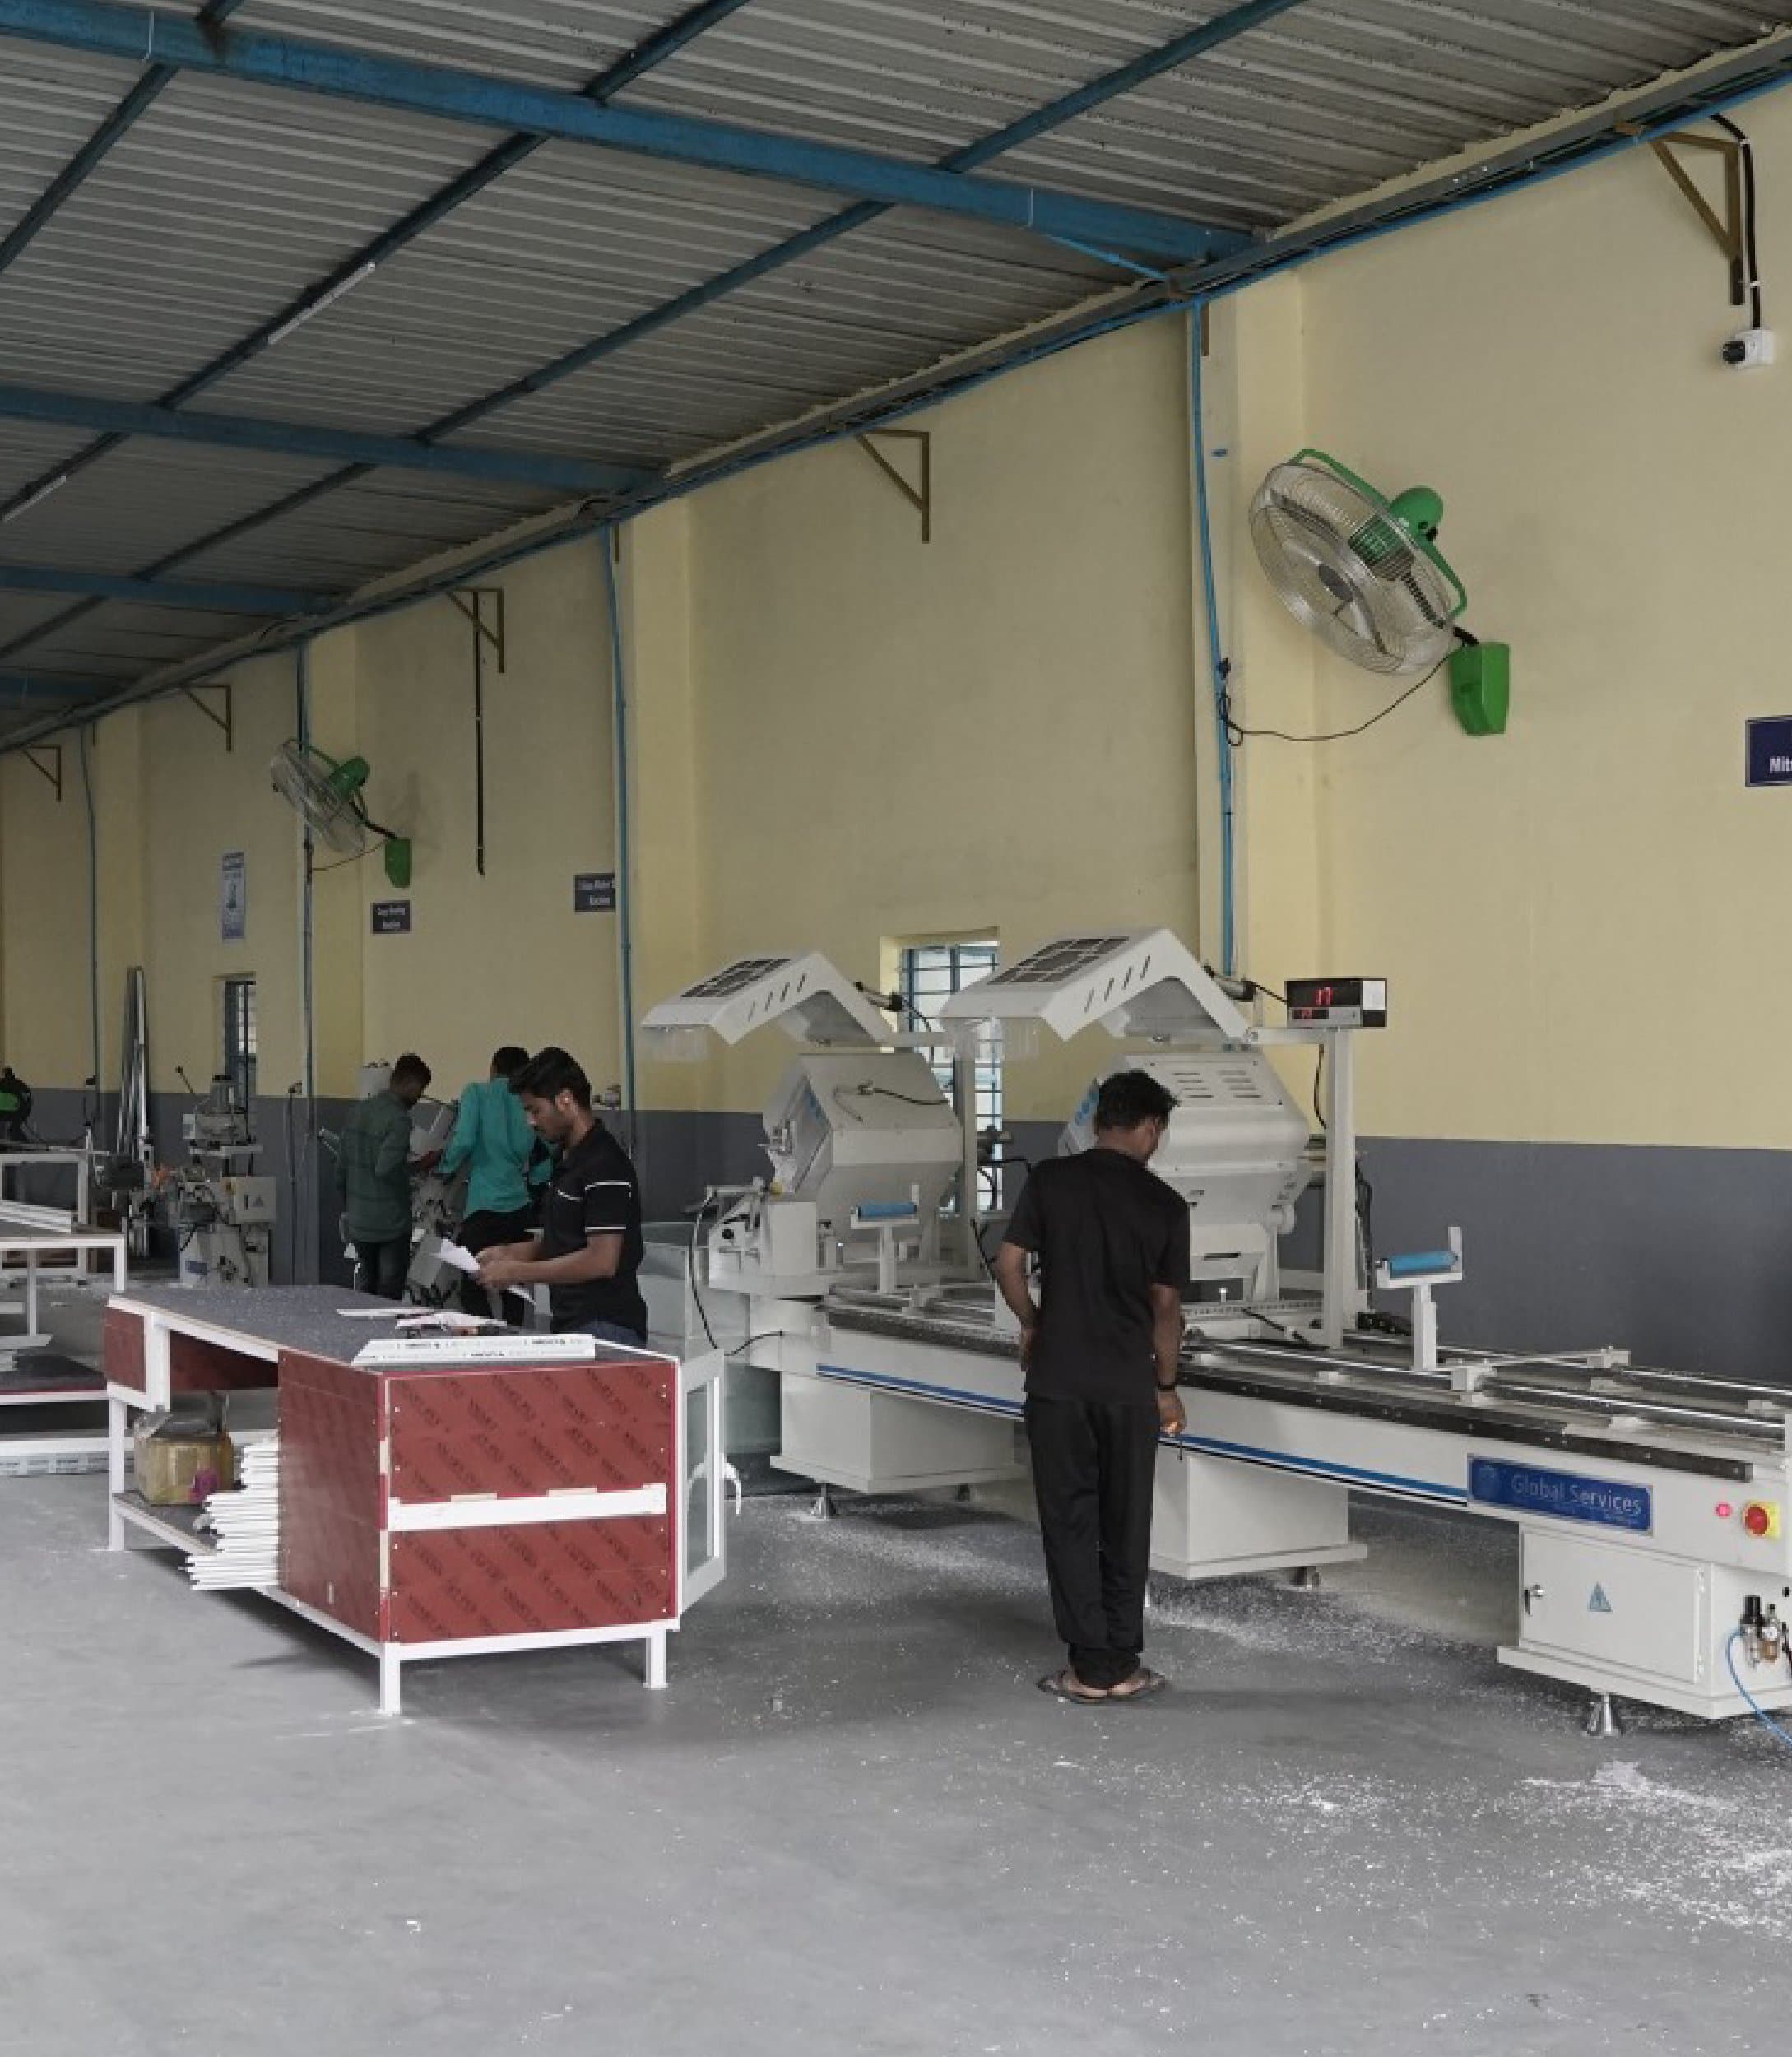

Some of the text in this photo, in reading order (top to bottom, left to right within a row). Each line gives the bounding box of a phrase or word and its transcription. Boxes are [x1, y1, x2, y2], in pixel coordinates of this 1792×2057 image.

[1770, 755, 1792, 772] Mit
[1511, 1474, 1563, 1502] Global
[1569, 1484, 1641, 1515] Services
